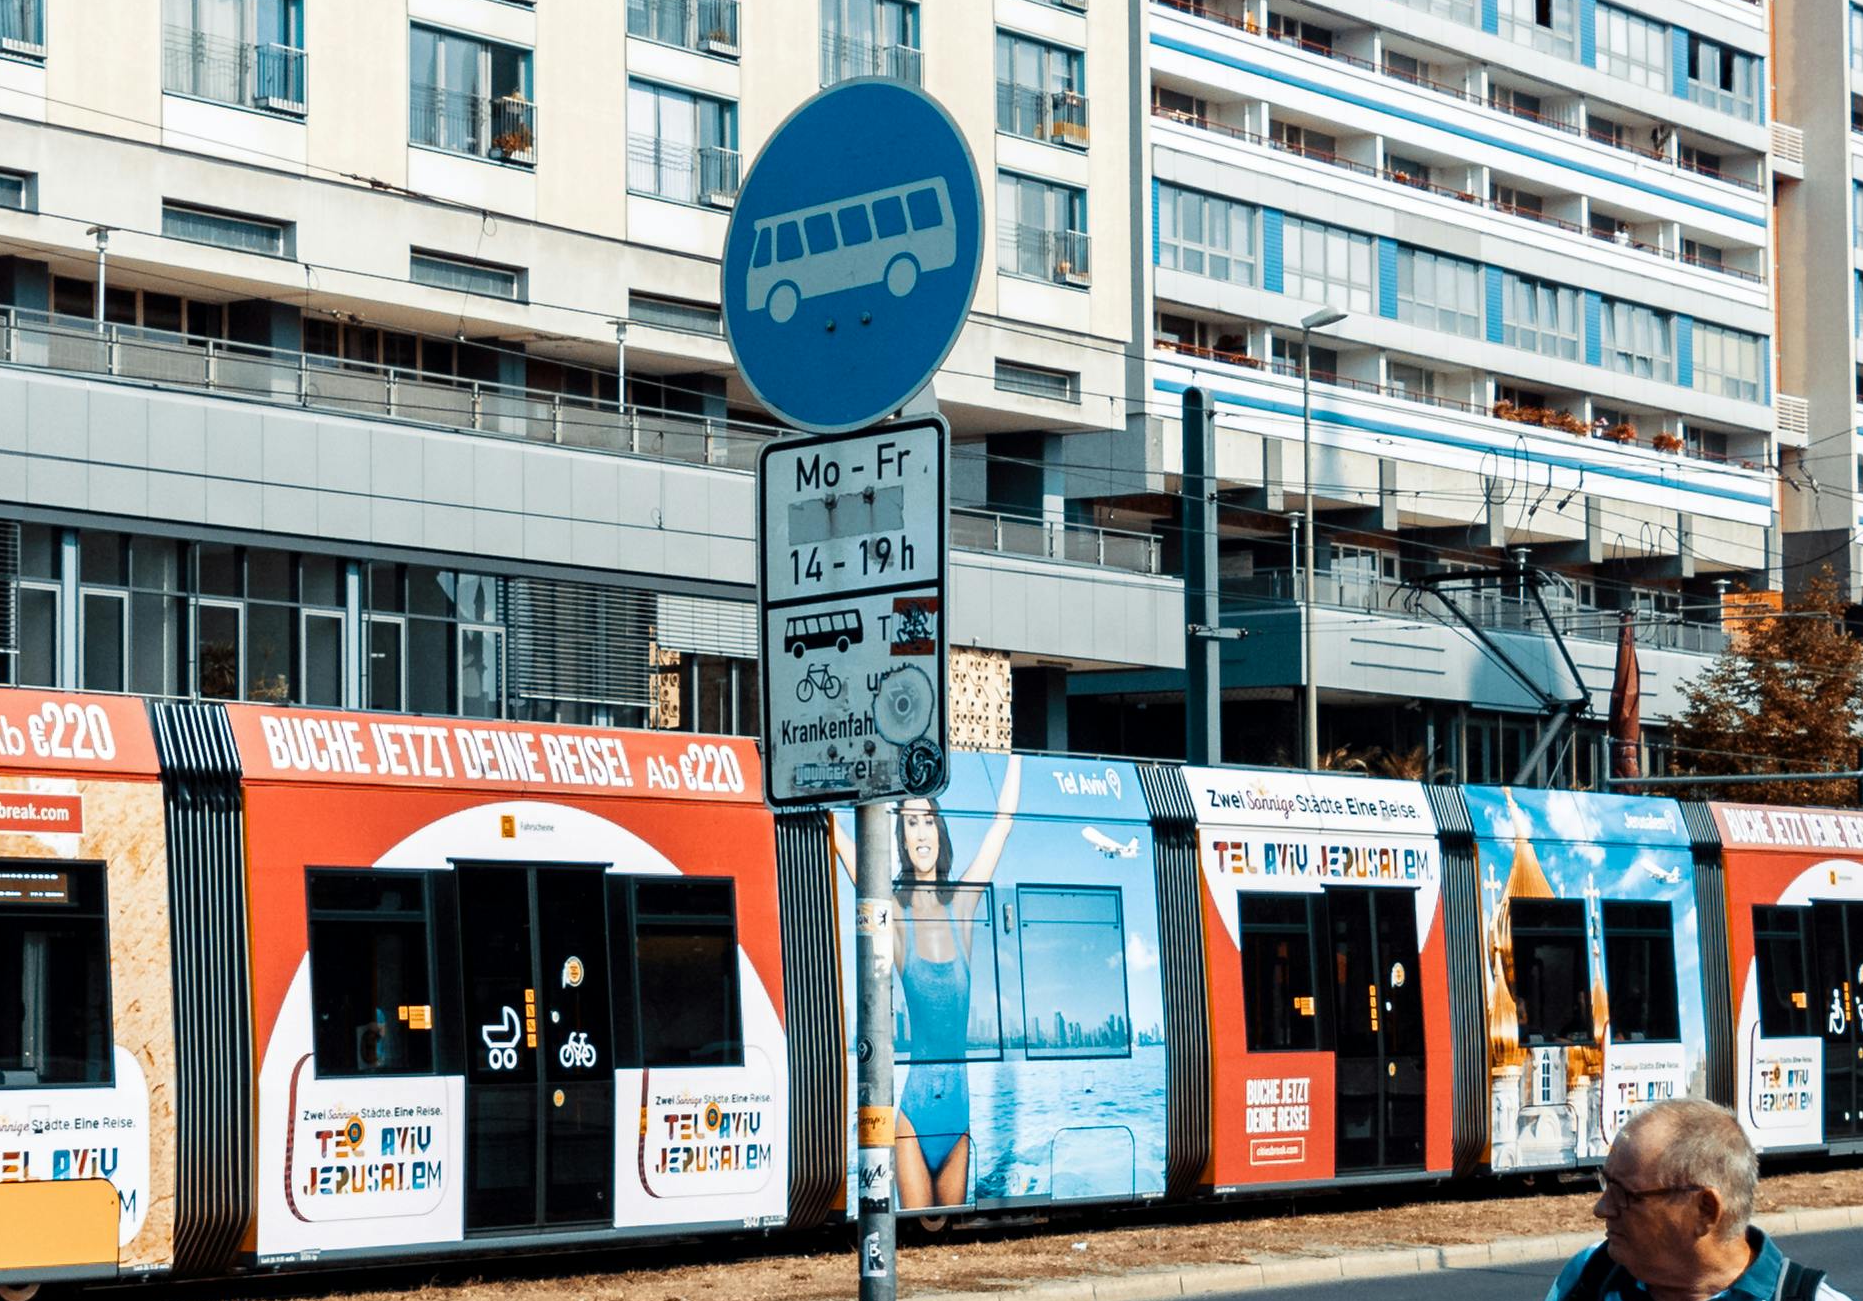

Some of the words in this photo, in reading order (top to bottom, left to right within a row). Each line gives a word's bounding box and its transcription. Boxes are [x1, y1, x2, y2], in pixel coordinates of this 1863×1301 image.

[796, 454, 840, 492] Mo
[877, 442, 912, 480] Fr
[790, 547, 823, 585] 14
[859, 537, 891, 575] 19
[901, 535, 914, 571] h
[28, 701, 116, 760] €220
[260, 715, 371, 774] BUCHE
[369, 722, 455, 778] JETZT
[453, 727, 546, 783] DEINE
[539, 733, 634, 788] REISE!
[646, 755, 680, 790] Ab
[679, 743, 744, 794] €220
[1052, 771, 1079, 795] Tel
[1079, 772, 1108, 796] Aviv
[1206, 789, 1244, 809] Zwei
[1246, 790, 1296, 819] Sonnige
[1347, 797, 1377, 816] Eine
[1380, 800, 1421, 819] Reise.
[1721, 807, 1772, 843] BUCHE
[1213, 841, 1257, 874] TEL
[655, 1096, 675, 1105] Zwei
[731, 1094, 750, 1103] Eine
[1246, 1078, 1281, 1106] BUCHE
[74, 1117, 100, 1129] Eine
[103, 1116, 136, 1128] Reise.
[303, 1110, 327, 1121] Zwei
[394, 1107, 414, 1117] Eine
[416, 1106, 443, 1116] Reise.
[664, 1113, 705, 1140] TEL
